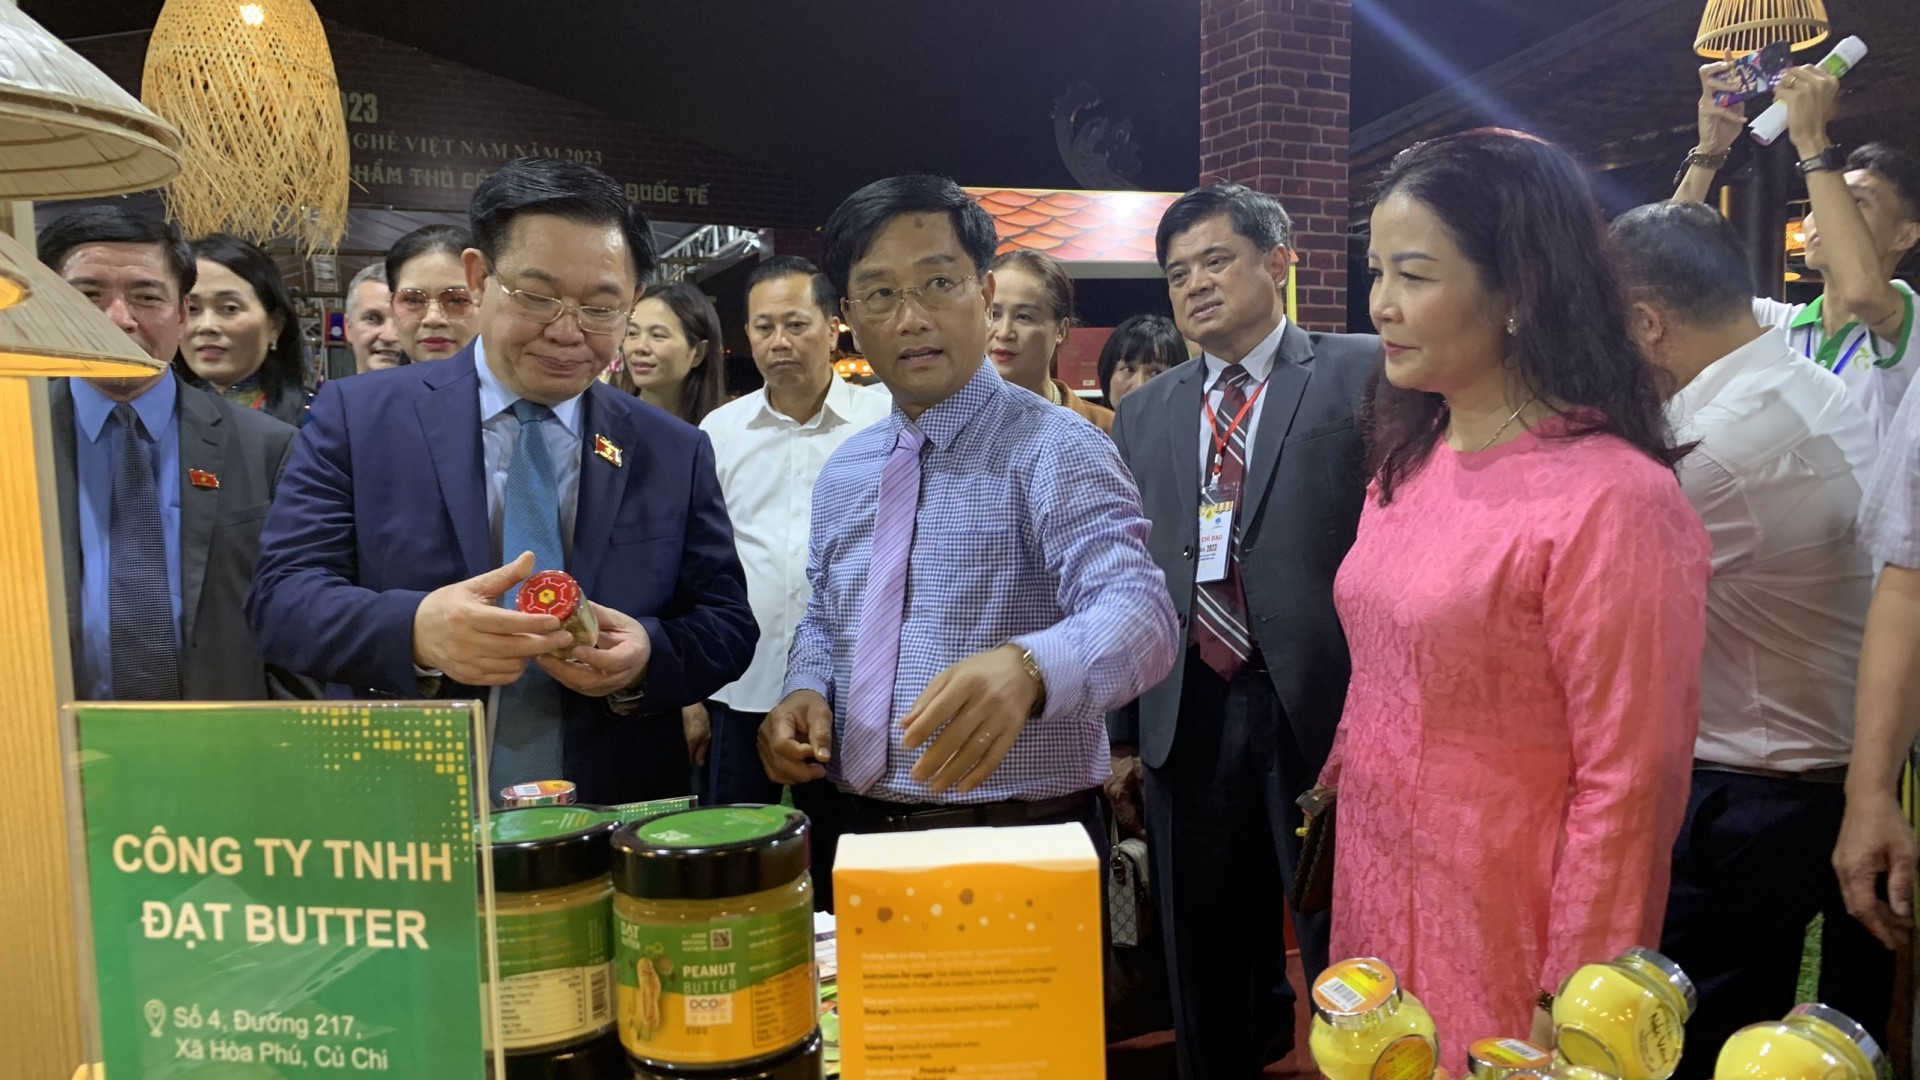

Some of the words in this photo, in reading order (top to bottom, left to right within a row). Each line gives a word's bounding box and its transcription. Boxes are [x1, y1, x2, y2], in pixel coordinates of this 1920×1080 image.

[460, 139, 507, 158] NAM
[565, 148, 602, 166] 2023
[685, 182, 710, 205] TẾ
[113, 825, 243, 876] CÔNG
[254, 838, 312, 877] TY
[323, 840, 453, 882] TNHH
[141, 901, 231, 950] ĐẠT
[244, 905, 430, 950] BUTTER
[682, 962, 737, 978] PEANUT
[683, 978, 738, 994] BUTTER
[173, 1003, 202, 1029] Số
[207, 1006, 228, 1032] 4,
[233, 1009, 309, 1038] Đường
[315, 1015, 362, 1040] 217,
[175, 1038, 204, 1060] Xã
[259, 1041, 307, 1068] Phú,
[314, 1044, 345, 1070] Củ
[351, 1046, 388, 1070] Chi
